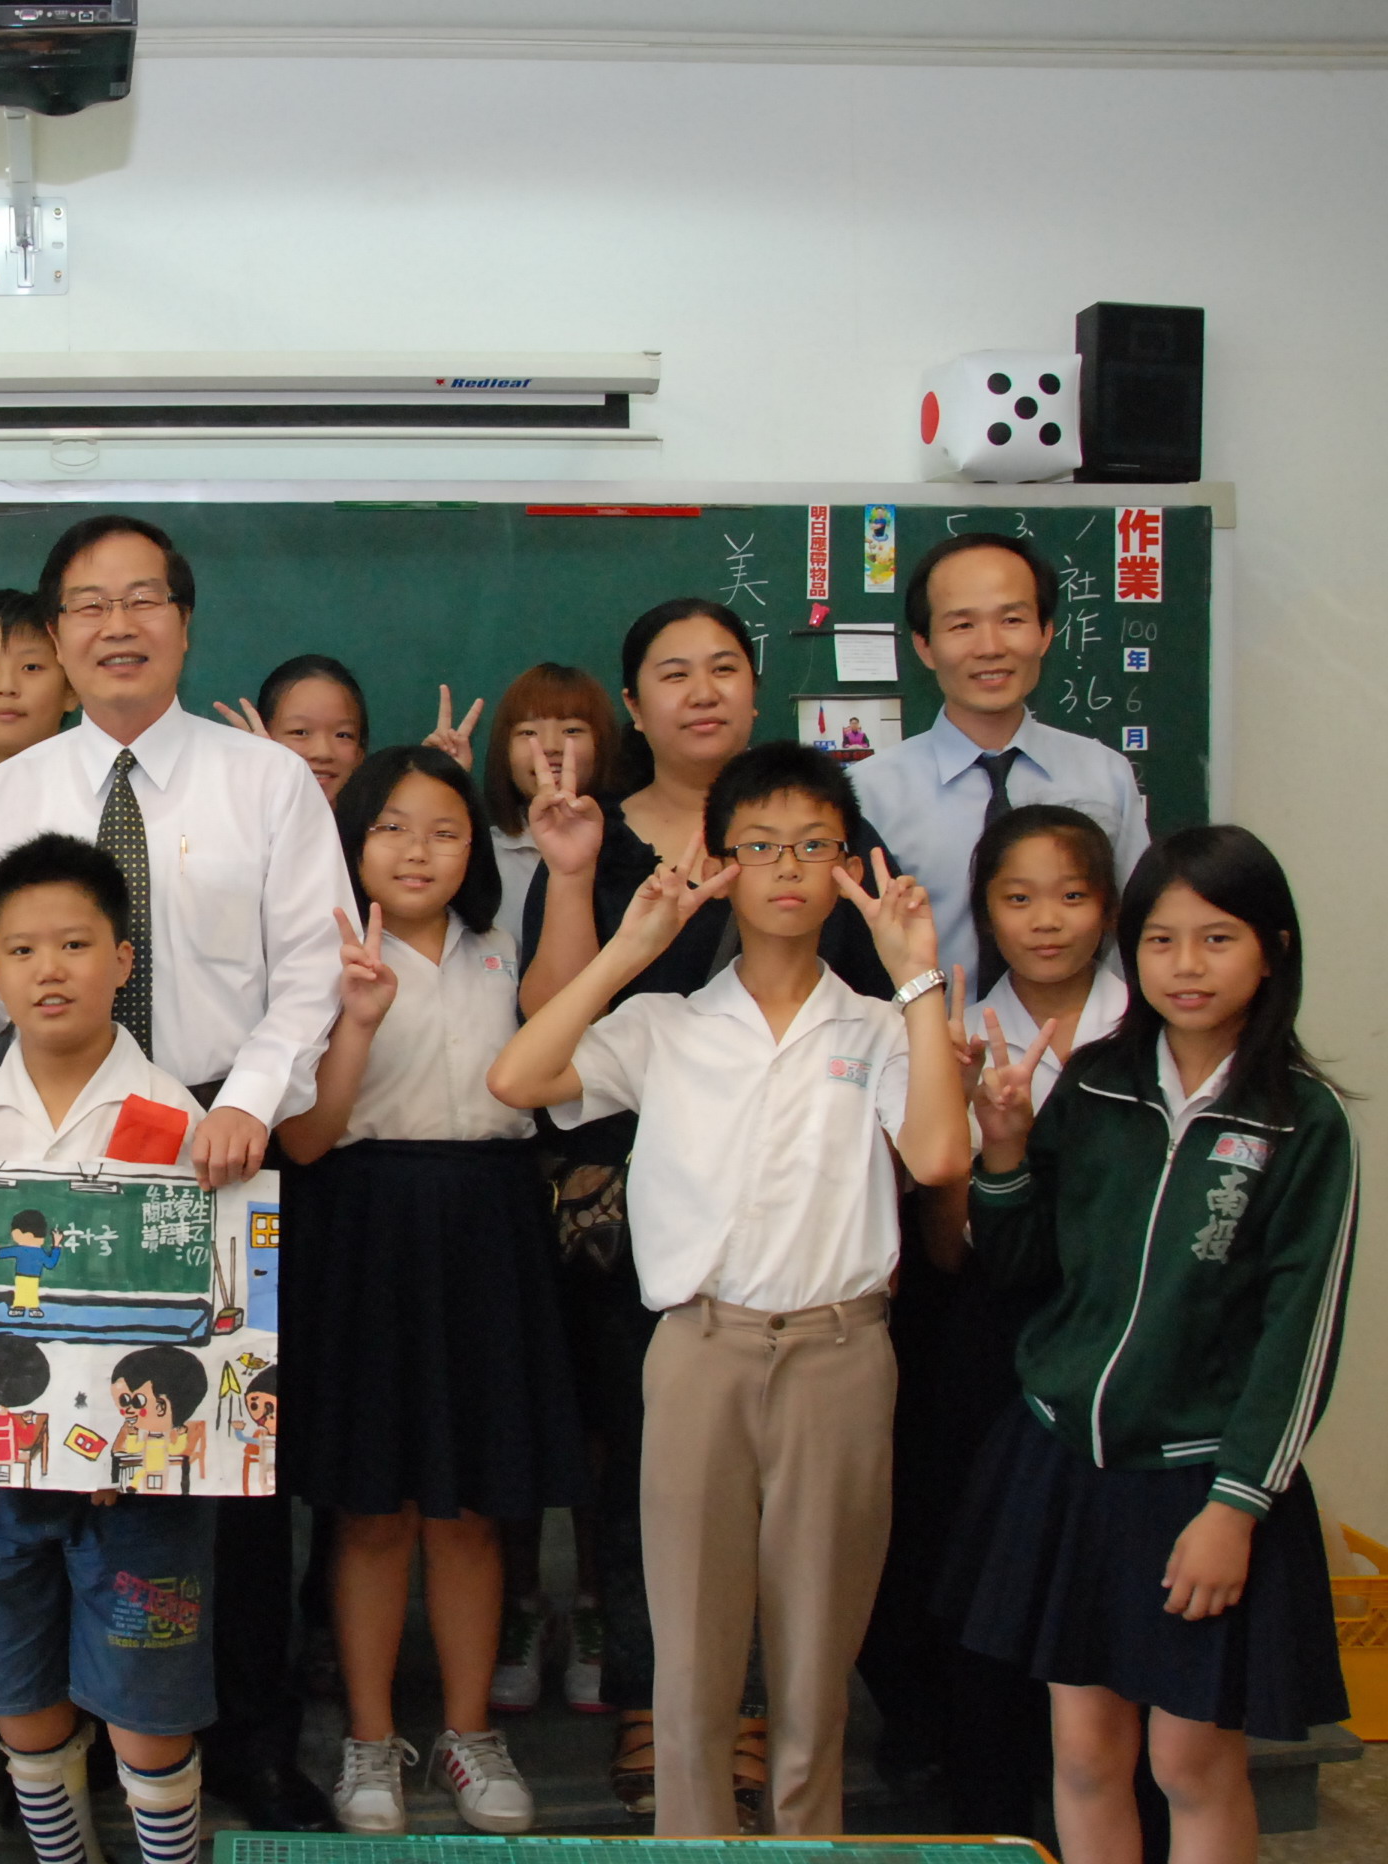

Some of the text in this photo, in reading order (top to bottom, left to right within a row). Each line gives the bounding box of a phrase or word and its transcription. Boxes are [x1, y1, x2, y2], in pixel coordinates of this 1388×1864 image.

[451, 378, 532, 389] Redleaf
[1117, 508, 1161, 600] 作業
[1120, 616, 1158, 644] 100
[1127, 650, 1147, 670] 年
[1126, 686, 1142, 712] 6
[1125, 728, 1144, 749] 月
[1191, 1165, 1249, 1264] 南投
